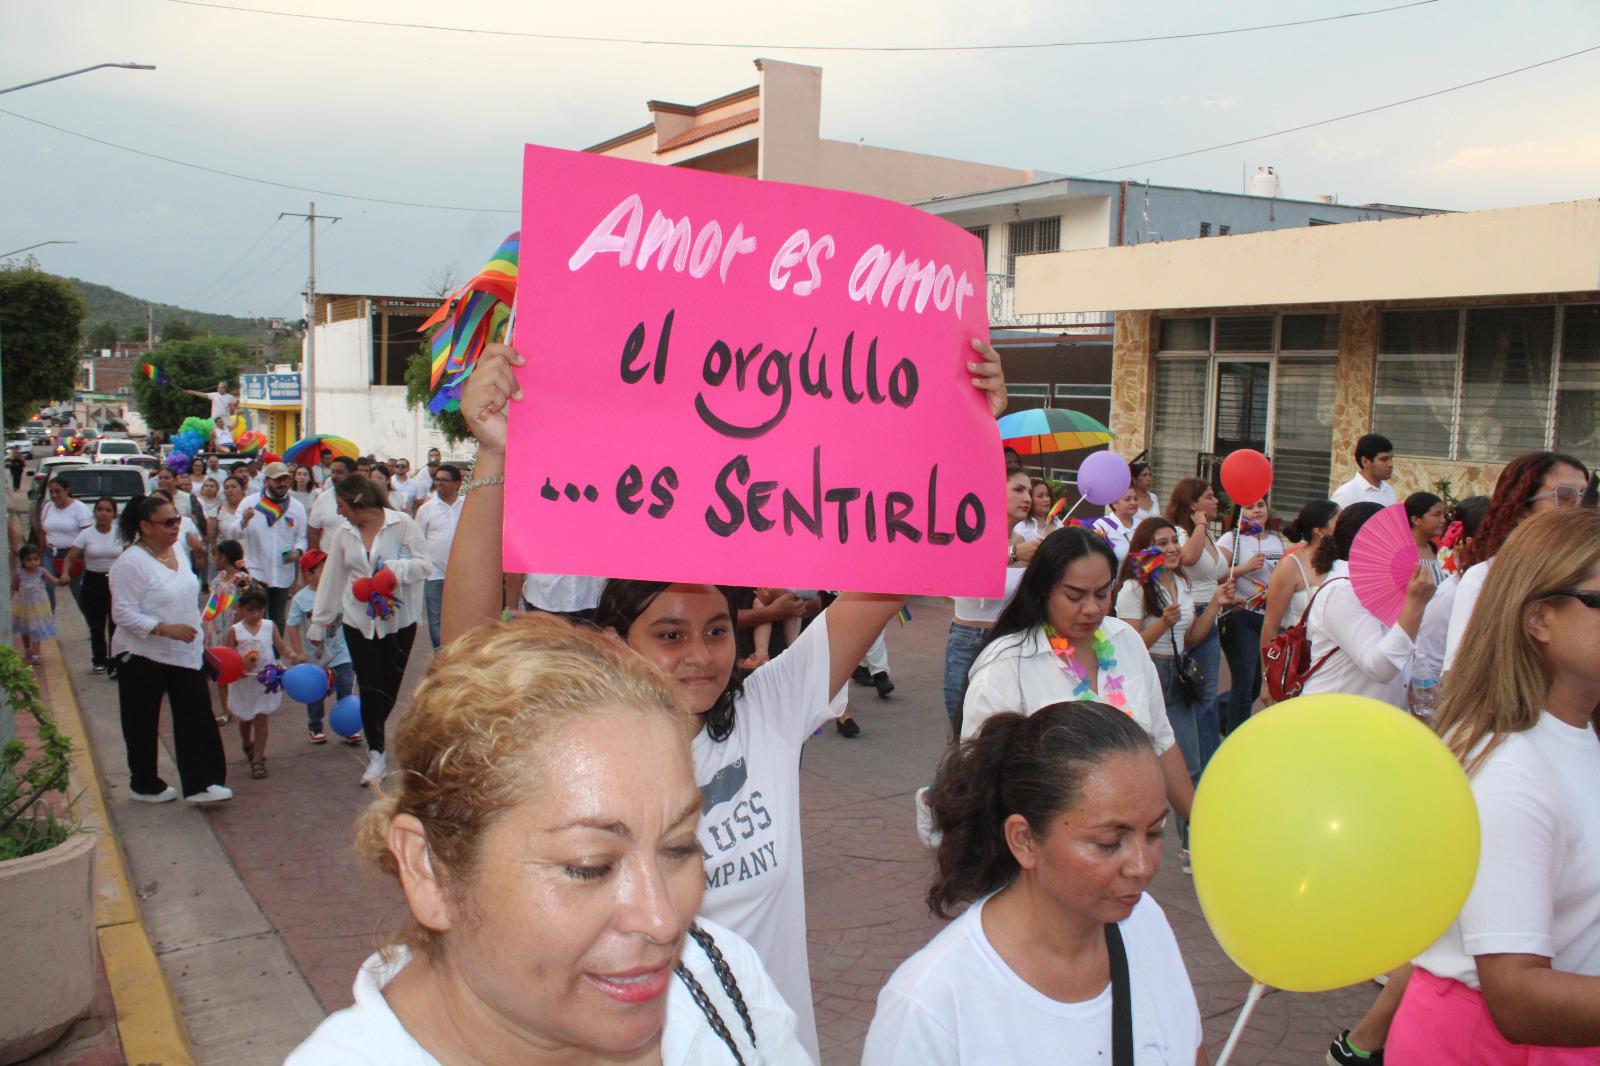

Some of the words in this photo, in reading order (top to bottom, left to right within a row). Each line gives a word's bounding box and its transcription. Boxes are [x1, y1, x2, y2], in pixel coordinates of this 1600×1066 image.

[568, 193, 757, 284] Amor
[769, 228, 836, 297] es
[848, 243, 974, 320] amor
[620, 308, 675, 385] el
[704, 445, 986, 546] SENTIRLO
